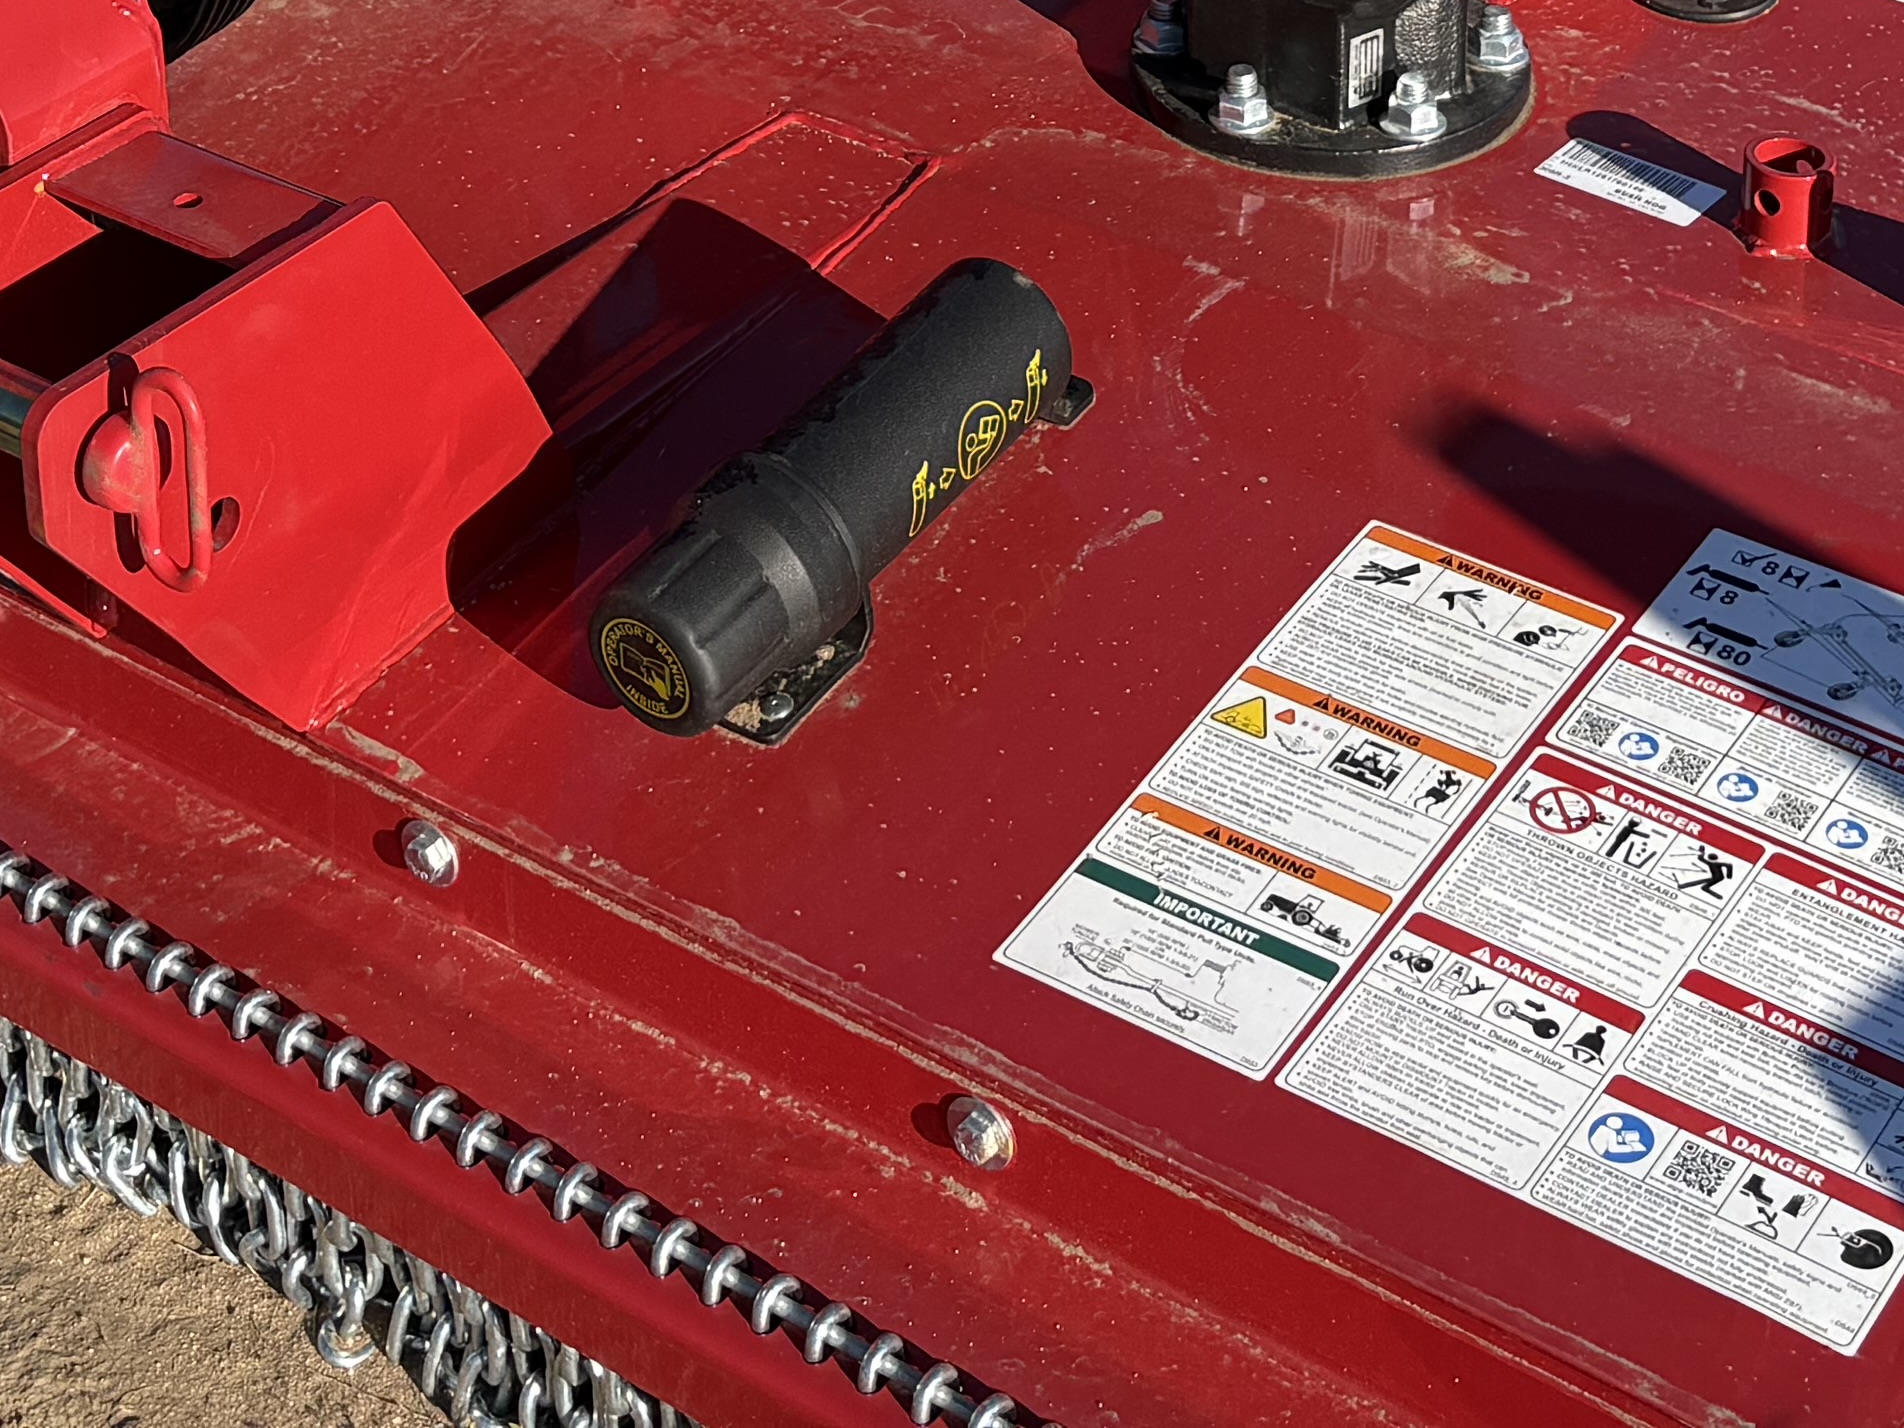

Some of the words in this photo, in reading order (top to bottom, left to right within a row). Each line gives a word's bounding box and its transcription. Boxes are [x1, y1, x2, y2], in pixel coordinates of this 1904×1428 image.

[1645, 200, 1668, 211] HOG
[1453, 560, 1545, 601] WARNING
[1760, 560, 1781, 576] 8
[1717, 589, 1739, 606] 8
[606, 624, 654, 666] OPERATOR'S
[656, 643, 685, 698] MANUAL
[1715, 642, 1753, 668] 80
[626, 684, 669, 713] INSIDE
[1659, 661, 1747, 703] PELIGRO
[1330, 703, 1423, 747] WARNING
[1783, 712, 1869, 753] DANGER
[1617, 792, 1703, 836] DANGER
[1222, 834, 1318, 880] WARNING
[1525, 829, 1575, 855] THROWN
[1574, 851, 1629, 879] OBJECTS
[1629, 874, 1679, 901] HAZARD
[1151, 892, 1261, 946] IMPORTANT
[1790, 888, 1887, 935] ENTANGLEMENT
[1492, 955, 1582, 1003] DANGER
[1392, 985, 1417, 1001] Run
[1414, 995, 1443, 1013] Over
[1441, 1008, 1482, 1031] Hazard
[1486, 1028, 1521, 1050] Death
[1518, 1043, 1534, 1056] or
[1532, 1050, 1567, 1071] Injury
[1696, 999, 1749, 1029] Crushing
[1747, 1023, 1790, 1047] Hazard
[1795, 1044, 1831, 1066] Death
[1829, 1059, 1844, 1072] or
[1844, 1066, 1879, 1088] Injury
[1767, 1010, 1860, 1059] DANGER
[1729, 1134, 1827, 1187] DANGER
